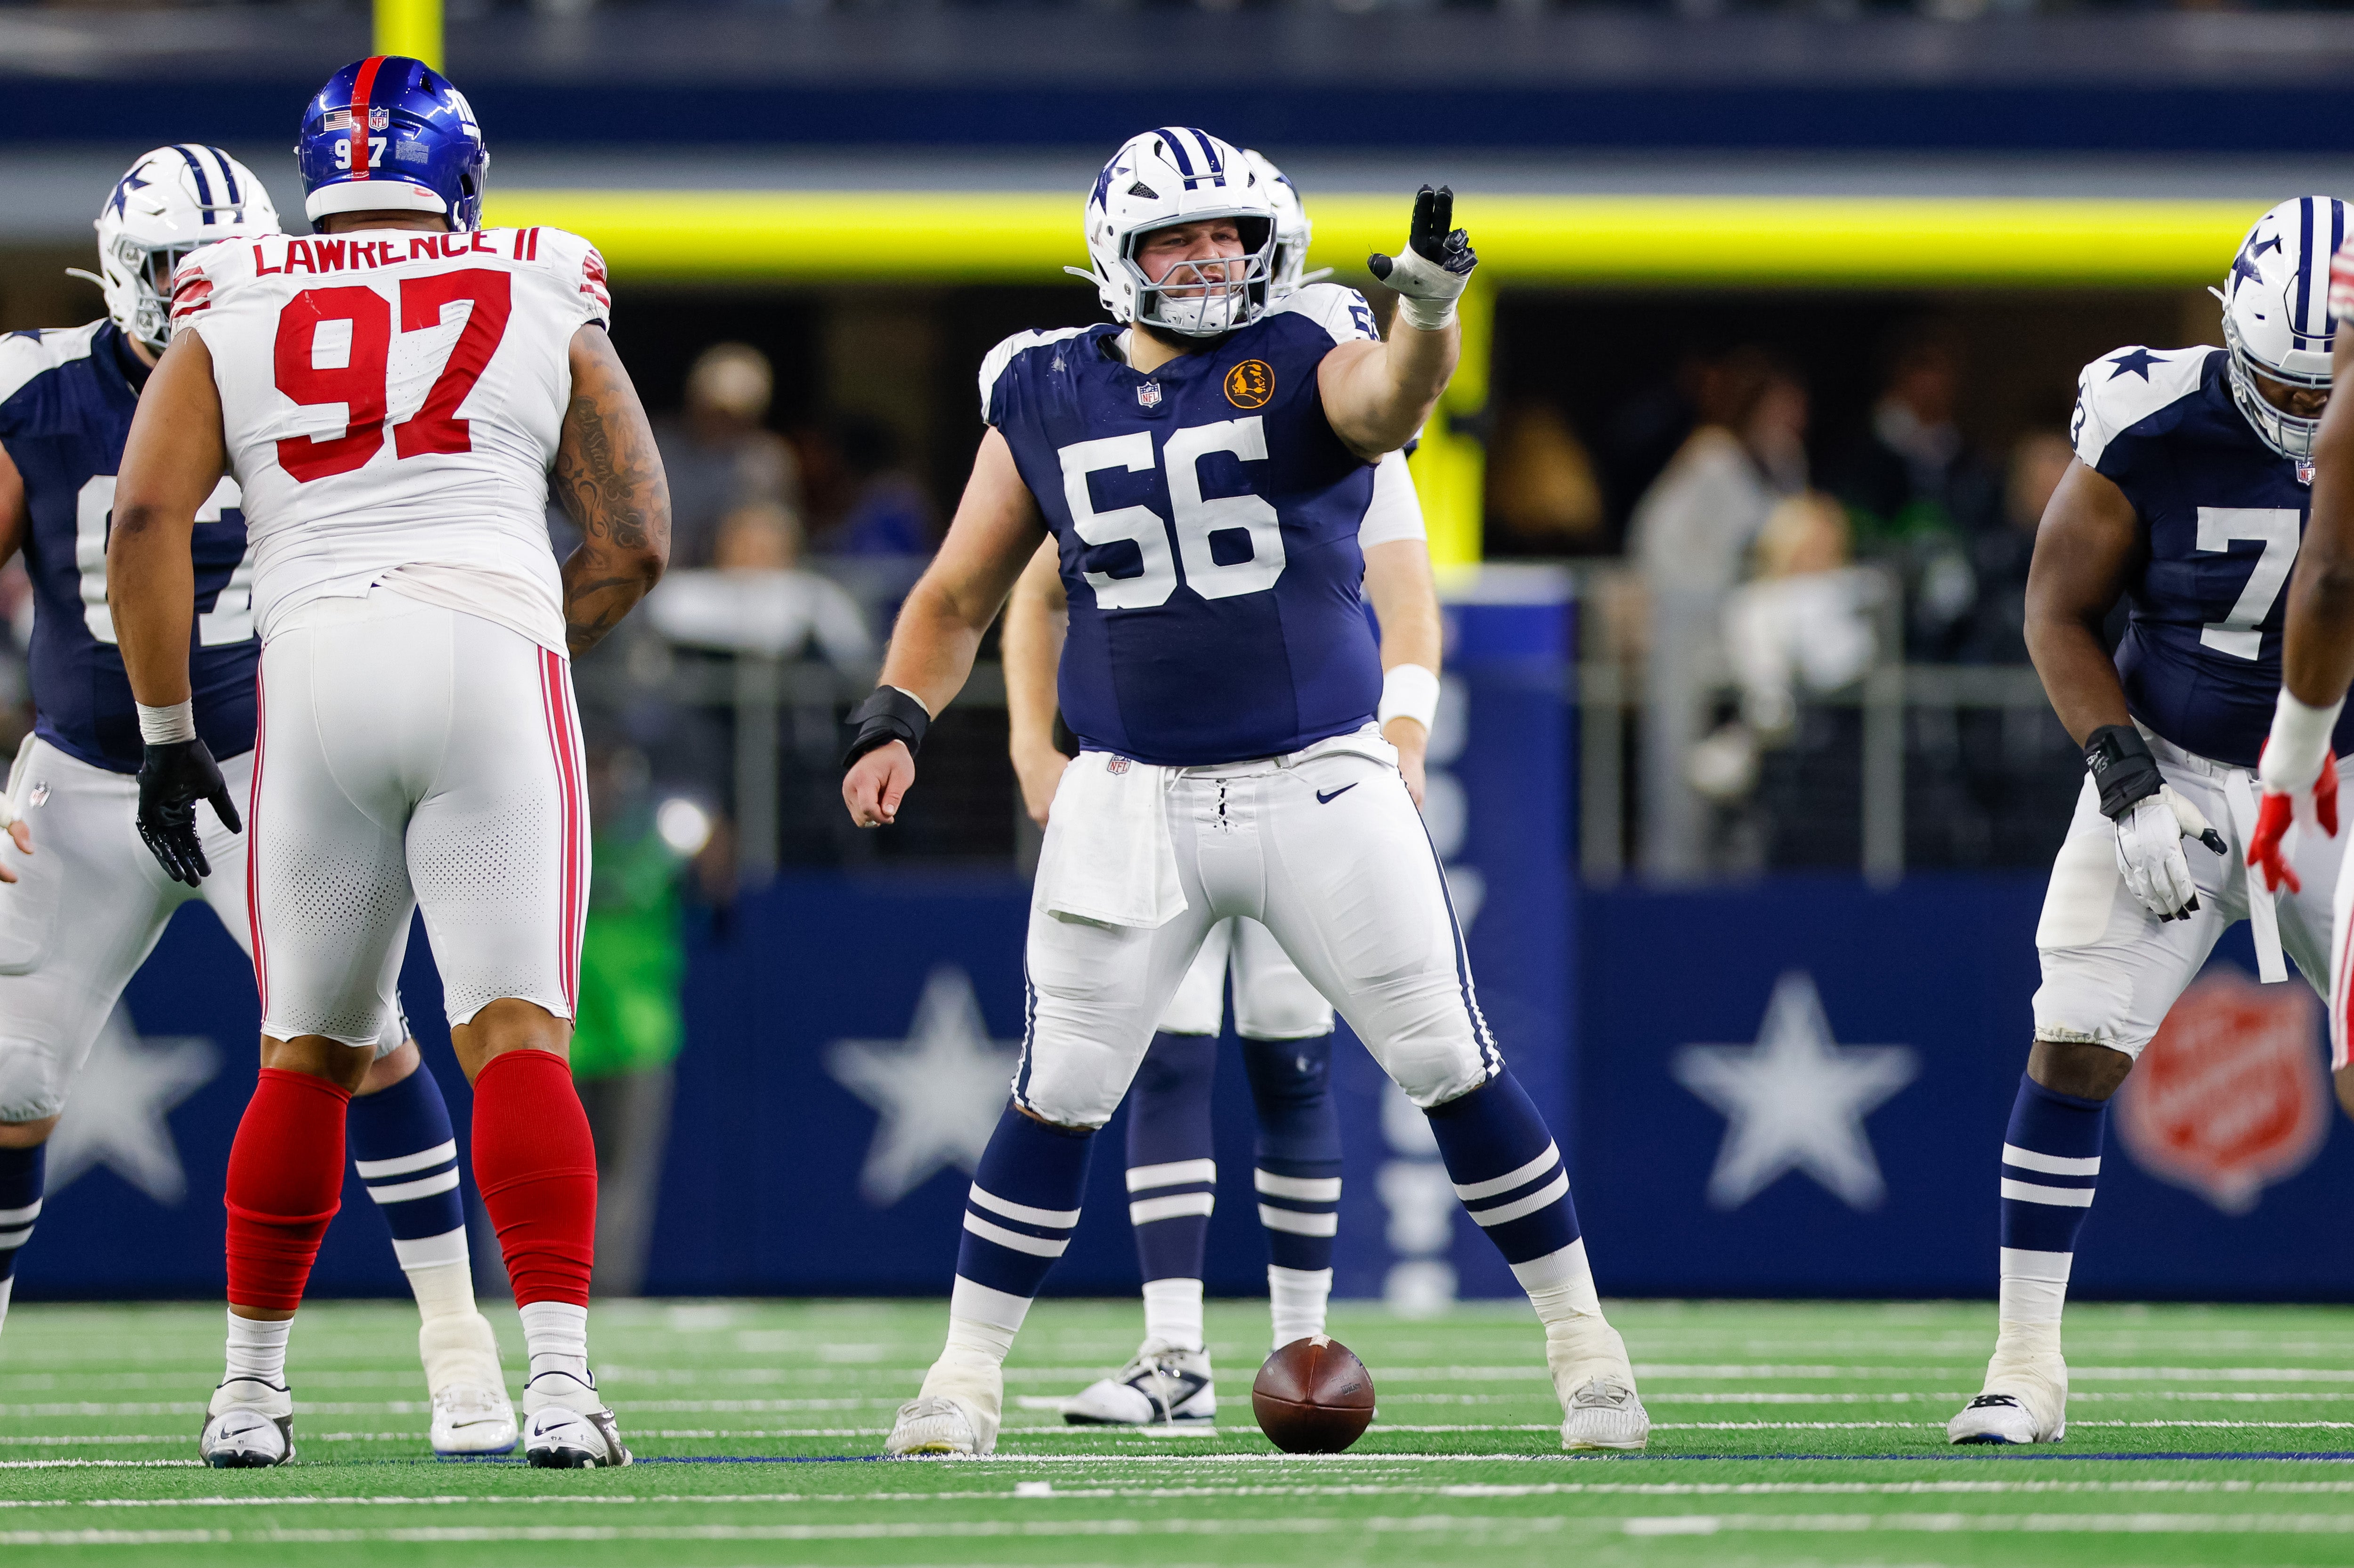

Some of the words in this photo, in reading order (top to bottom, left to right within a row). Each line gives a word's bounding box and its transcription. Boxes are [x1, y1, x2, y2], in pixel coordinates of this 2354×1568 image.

[372, 118, 386, 127] NFL
[335, 137, 387, 170] 97
[253, 229, 499, 277] LAWRENCE
[274, 268, 511, 483] 97
[1143, 393, 1158, 403] NFL
[1058, 415, 1286, 609] 56
[2196, 507, 2313, 660] 7
[1110, 761, 1128, 773] NFL
